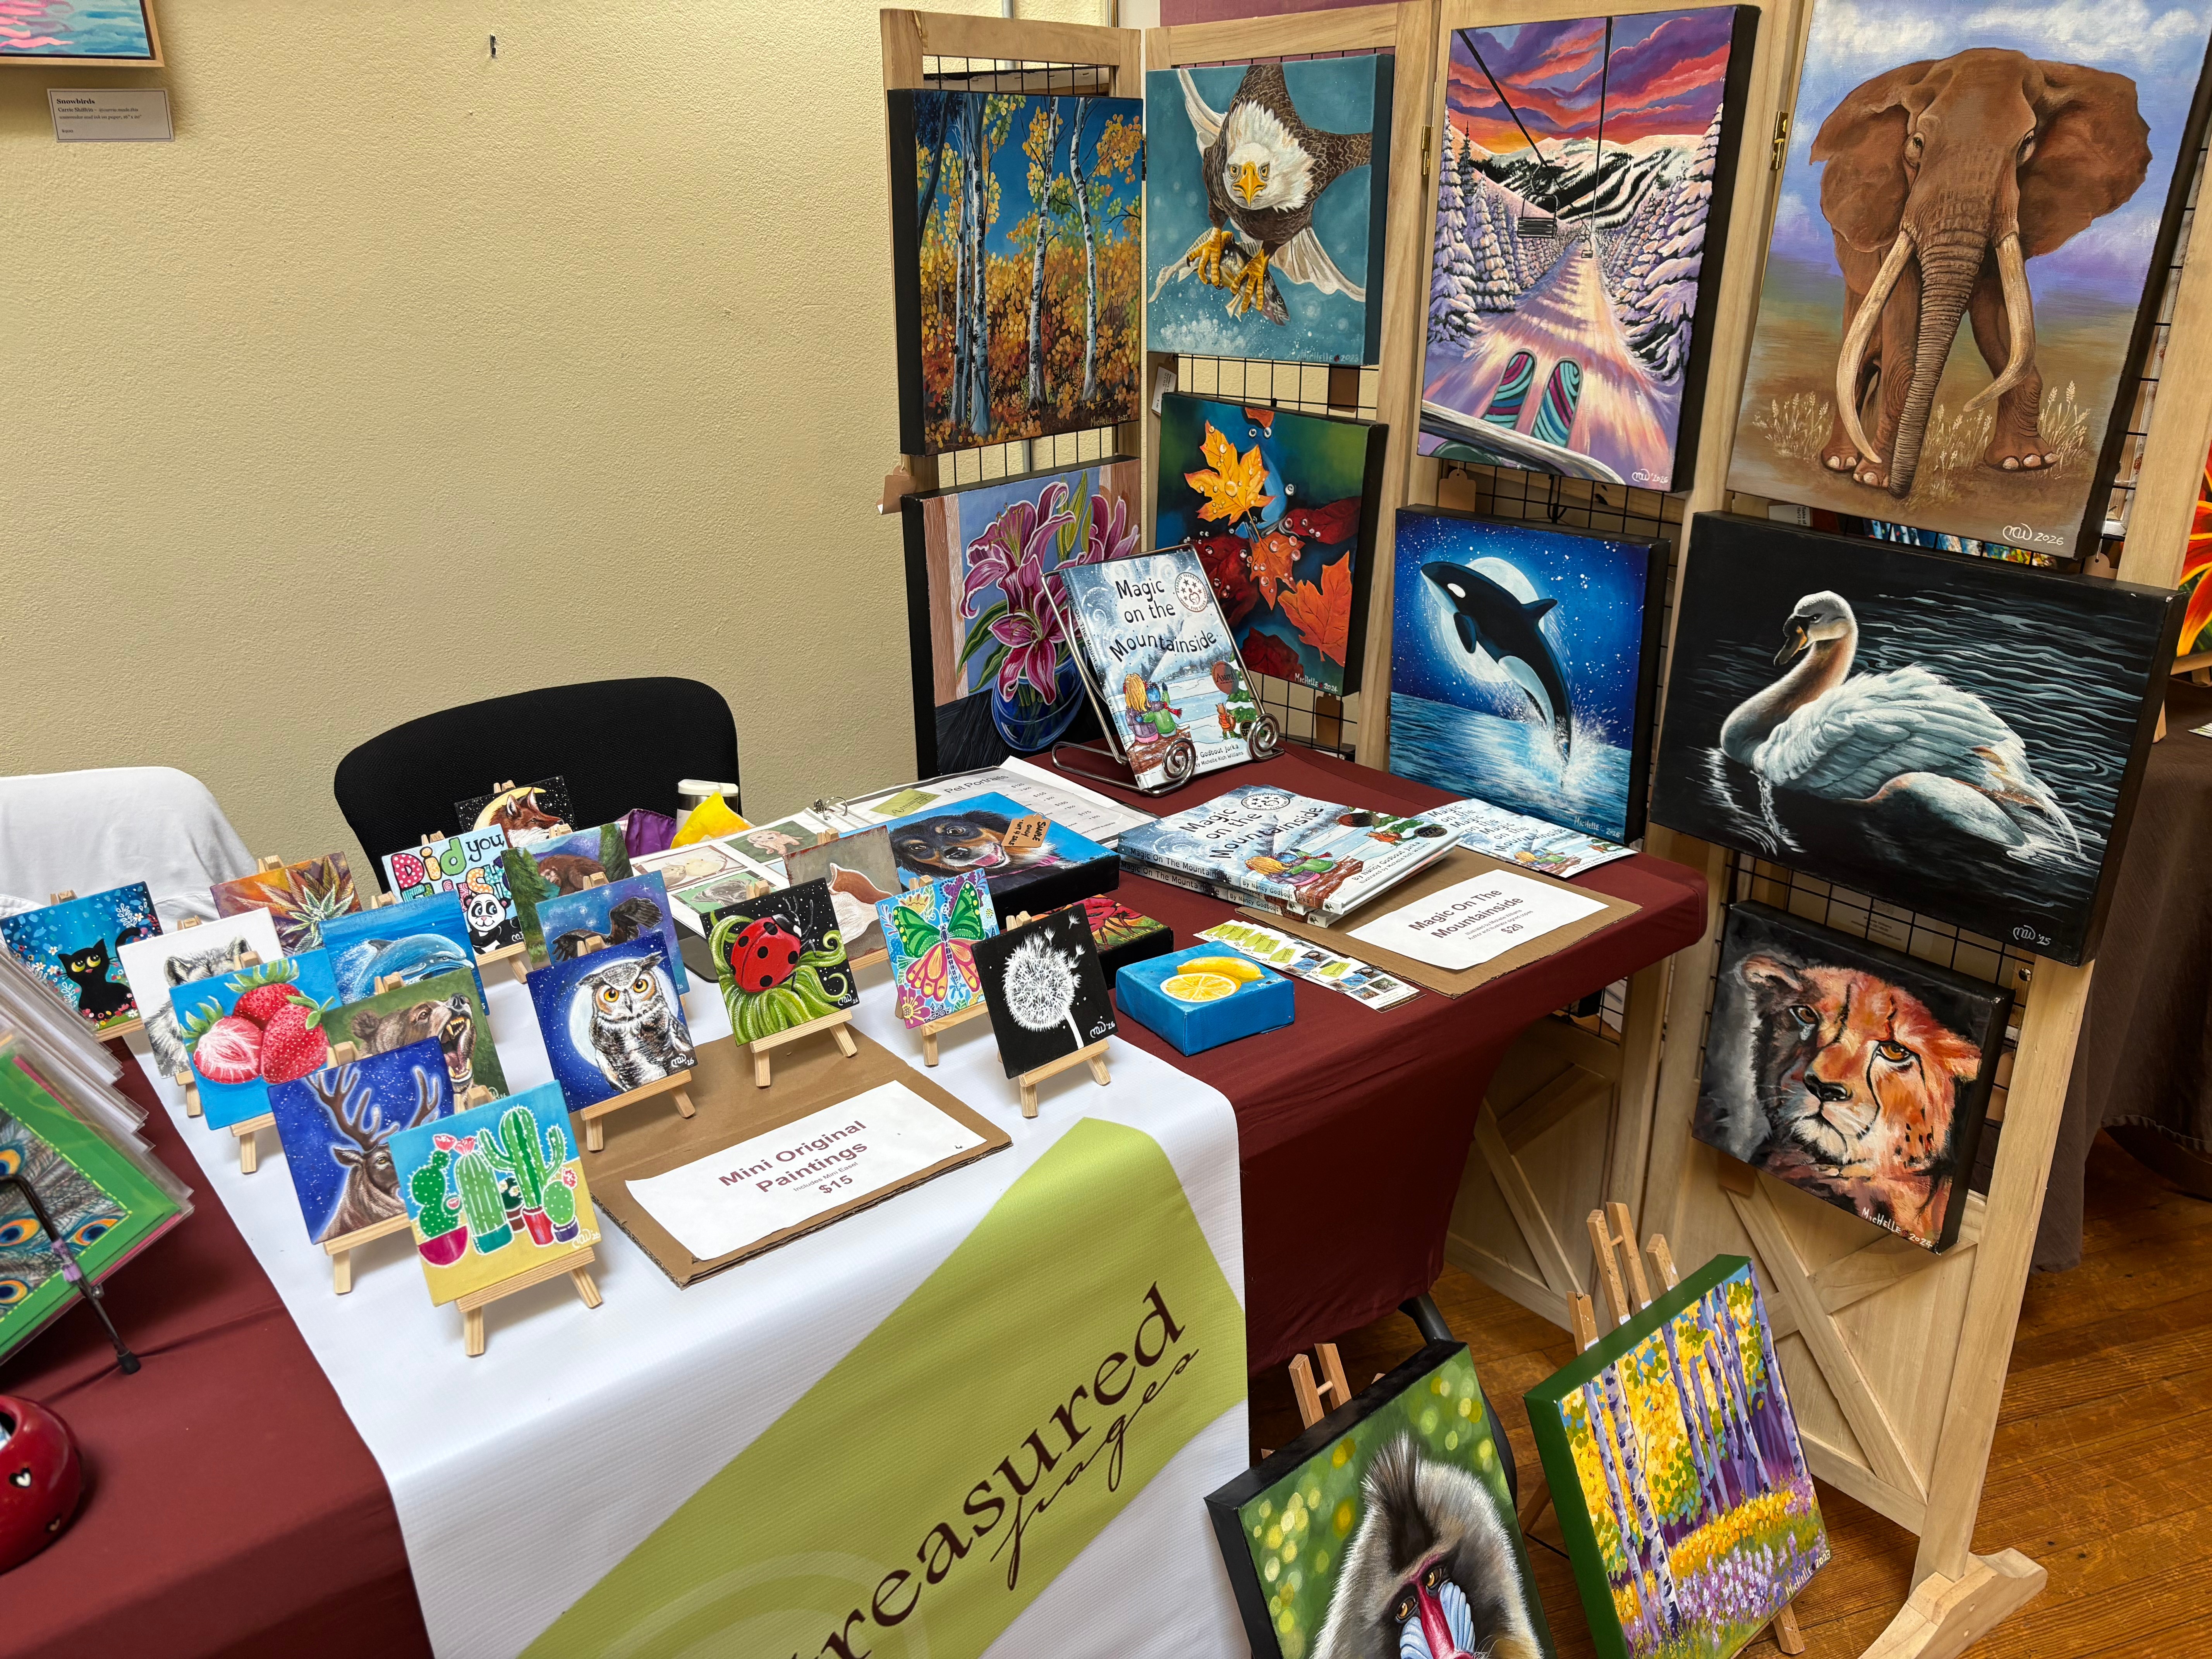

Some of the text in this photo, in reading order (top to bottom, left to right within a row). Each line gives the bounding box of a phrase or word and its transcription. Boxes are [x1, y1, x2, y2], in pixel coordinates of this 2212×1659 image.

[2034, 532, 2064, 545] 2026
[1115, 578, 1164, 602] Magic
[1066, 584, 1075, 607] Magic
[1075, 609, 1081, 620] On
[1124, 600, 1175, 623] on the
[1109, 630, 1217, 663] Mountainside
[1324, 683, 1338, 693] 2024
[1200, 744, 1239, 758] Godbout Jurka
[1201, 757, 1218, 766] Michelle
[944, 775, 1009, 793] Pet Portraits
[1179, 809, 1237, 832] Magic
[1427, 805, 1462, 817] Magic
[1449, 815, 1484, 828] Magic
[1206, 813, 1262, 839] on the
[1209, 807, 1324, 858] Mountainside
[1479, 822, 1515, 835] Magic
[1494, 828, 1566, 852] Mountainside
[391, 834, 504, 890] Did you
[1130, 848, 1232, 882] Magic On The Mountainside
[1361, 864, 1381, 875] Nancy
[1379, 850, 1405, 864] Godbout
[1404, 842, 1420, 851] Jurka
[1121, 861, 1219, 895] Magic On The Mountainside
[1252, 883, 1267, 892] Nancy
[1270, 888, 1293, 899] Godbout
[1238, 896, 1254, 905] Nancy
[1256, 901, 1279, 912] Godbout
[1408, 890, 1502, 930] Magic On The
[1431, 898, 1523, 938] Mountainside
[1465, 926, 1484, 935] Illustrated
[1489, 915, 1507, 924] Michelle
[1505, 909, 1522, 918] Williams
[1501, 924, 1524, 934] $20
[2037, 934, 2051, 945] '25
[718, 1120, 867, 1186] Mini Original
[756, 1143, 867, 1193] Paintings
[793, 1162, 859, 1192] Includes Mini Easel
[819, 1175, 853, 1194] $15
[1908, 1233, 1933, 1248] 2024
[790, 1281, 1185, 1659] reasured
[1815, 1549, 1831, 1568] 2023
